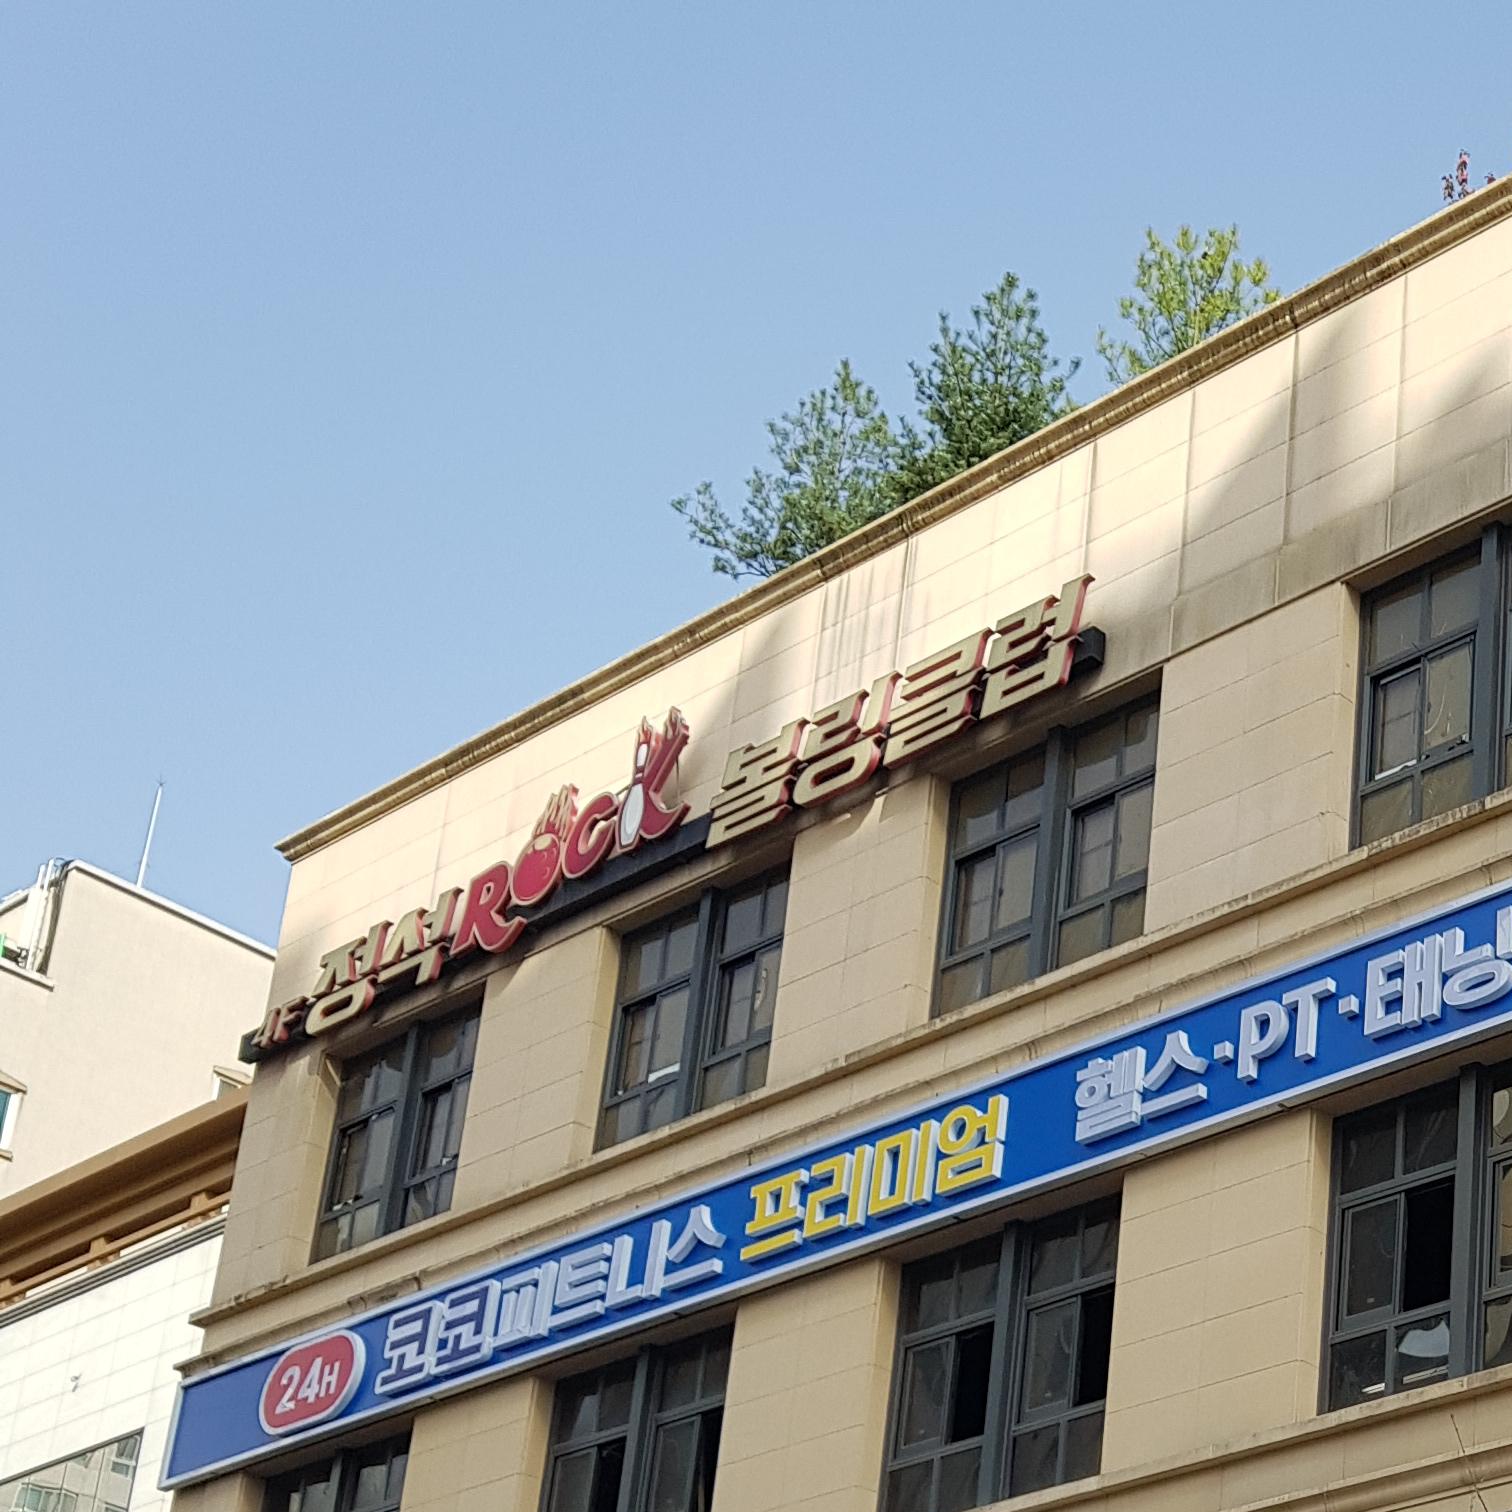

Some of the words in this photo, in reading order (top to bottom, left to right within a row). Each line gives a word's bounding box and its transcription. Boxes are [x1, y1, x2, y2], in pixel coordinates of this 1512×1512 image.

[251, 996, 309, 1049] 4F
[705, 573, 1096, 849] 볼링클럽
[278, 1352, 340, 1416] 24H
[374, 1204, 727, 1395] 코코피트니스
[740, 1094, 1009, 1263] 프리미엄
